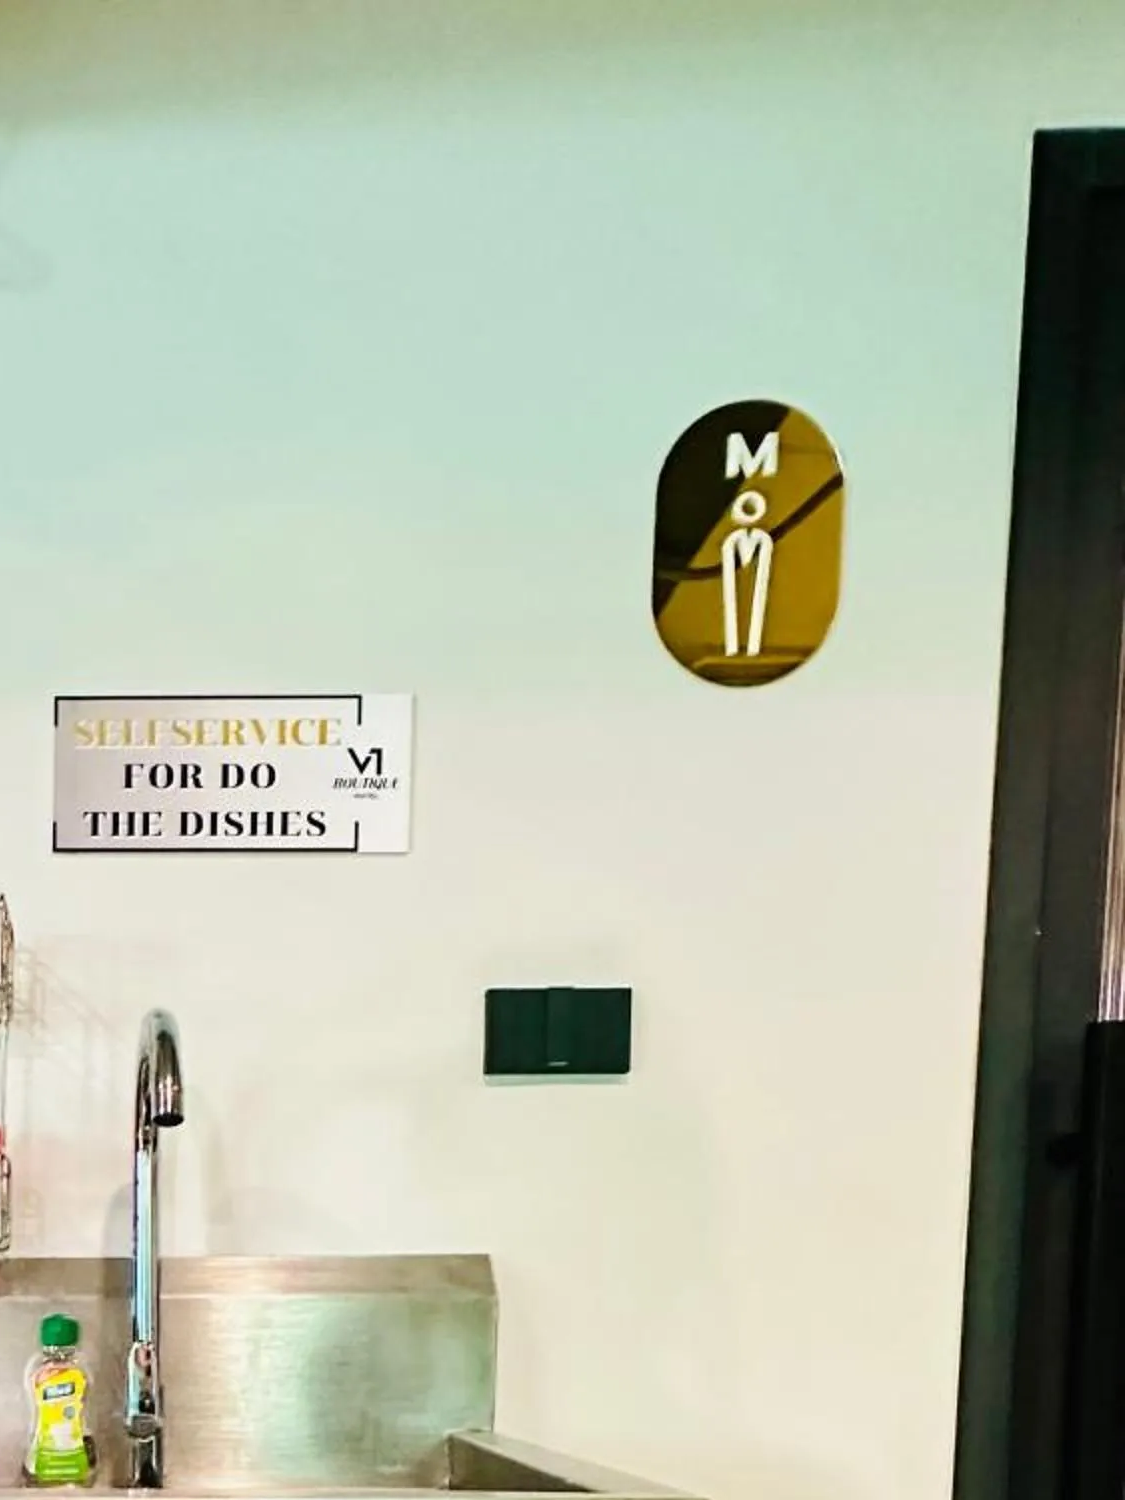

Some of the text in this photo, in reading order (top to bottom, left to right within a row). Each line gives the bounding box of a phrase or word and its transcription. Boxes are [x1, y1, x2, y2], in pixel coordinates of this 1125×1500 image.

[725, 432, 779, 478] M
[123, 763, 276, 789] FOR DO
[82, 811, 326, 836] THE DISHES
